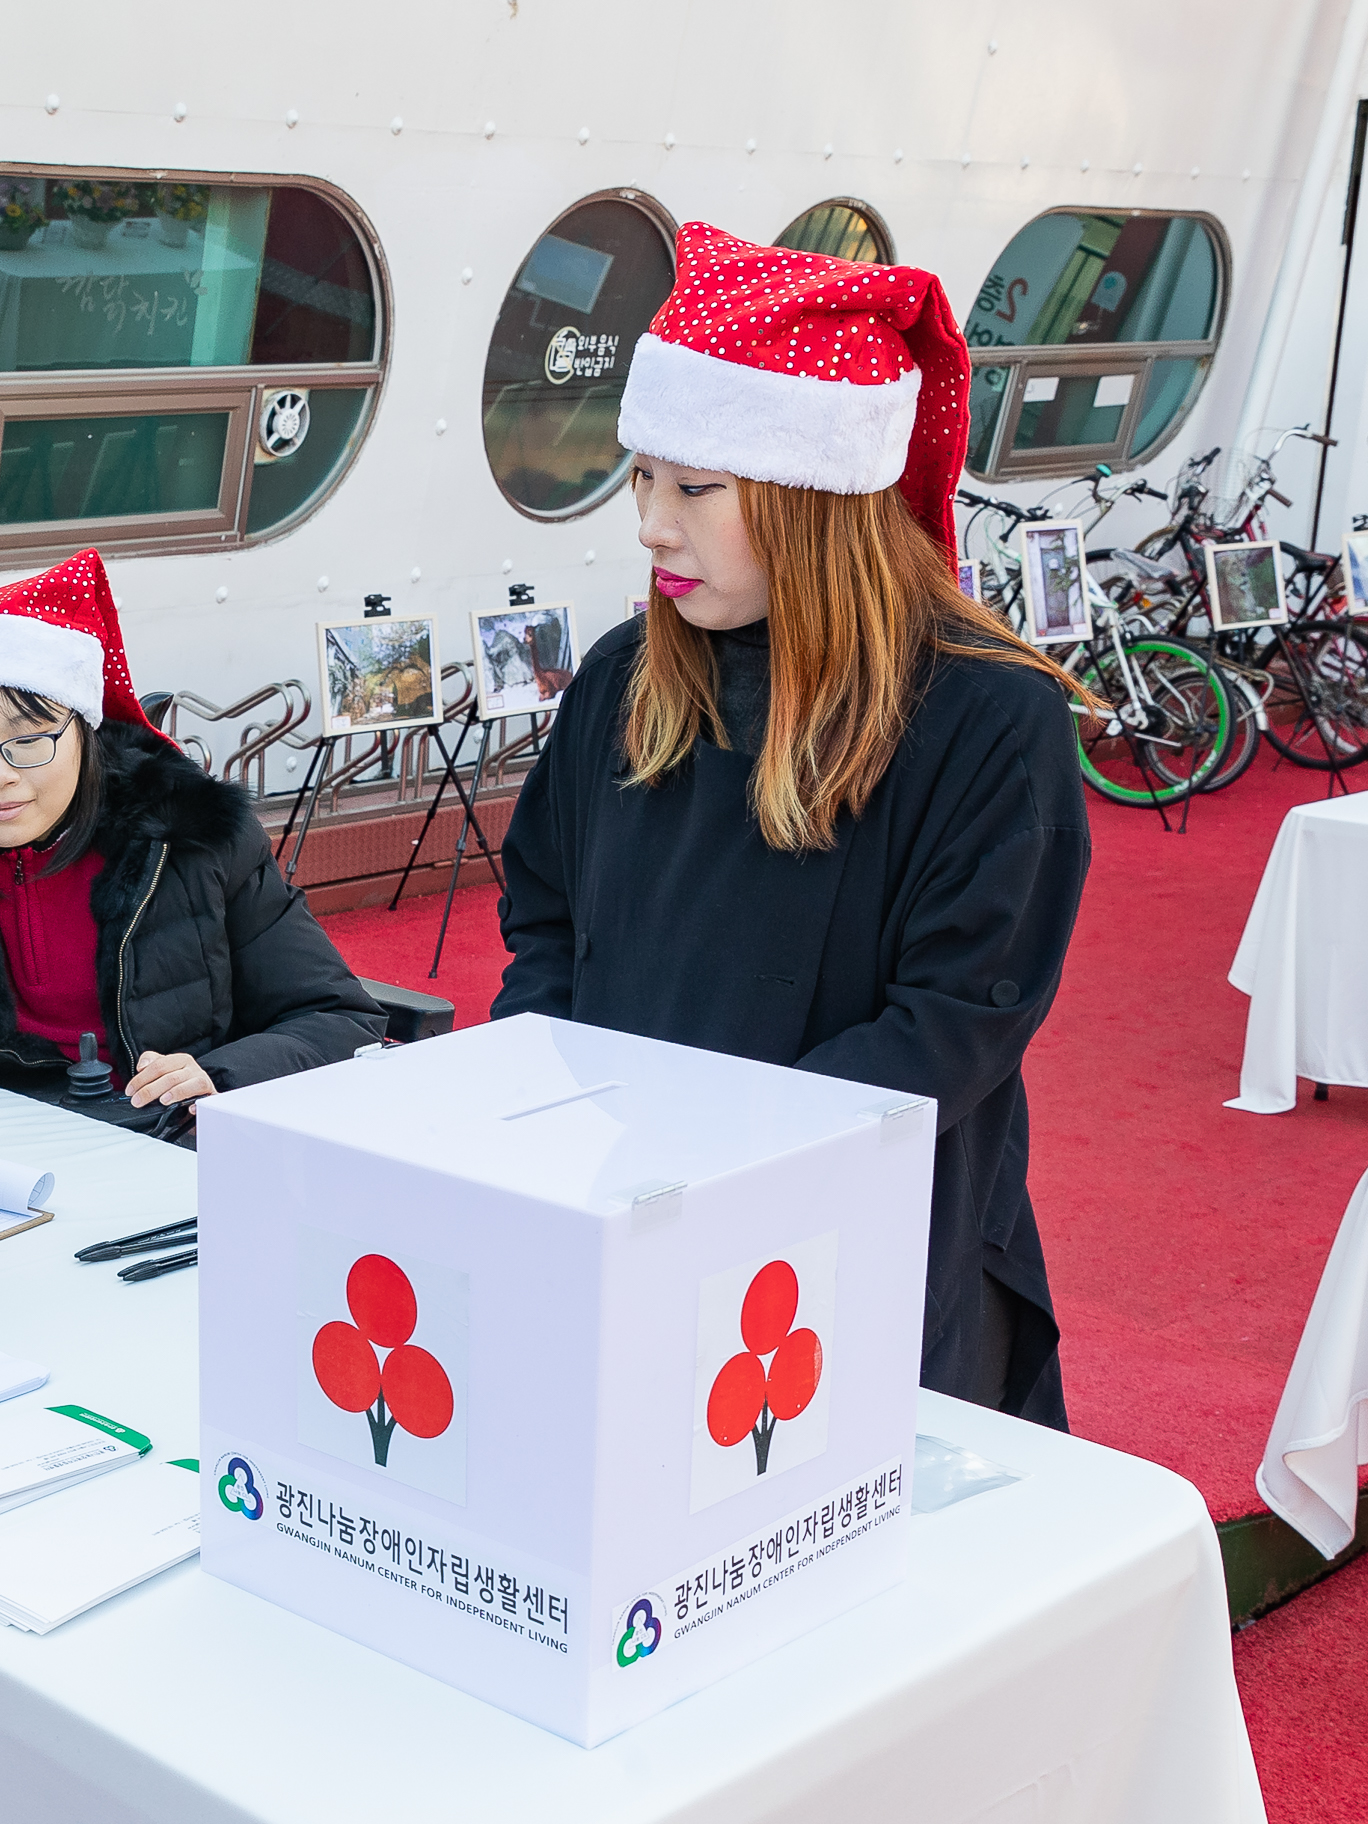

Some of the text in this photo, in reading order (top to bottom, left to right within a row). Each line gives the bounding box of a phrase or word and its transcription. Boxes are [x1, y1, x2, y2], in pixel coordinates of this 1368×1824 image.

[276, 1481, 568, 1634] 광진나눔장애인자립생활센터
[276, 1522, 568, 1653] GWANGJIN NANUM CENTER FOR INDEPENDENT LIVING
[674, 1463, 903, 1620] 광진나눔장애인자립생활센터
[674, 1604, 724, 1640] GWANGJIN
[726, 1584, 761, 1610] NANUM
[763, 1565, 795, 1590] CENTER
[797, 1554, 814, 1570] FOR
[816, 1520, 873, 1560] INDEPENDENT
[874, 1504, 901, 1527] LIVING
